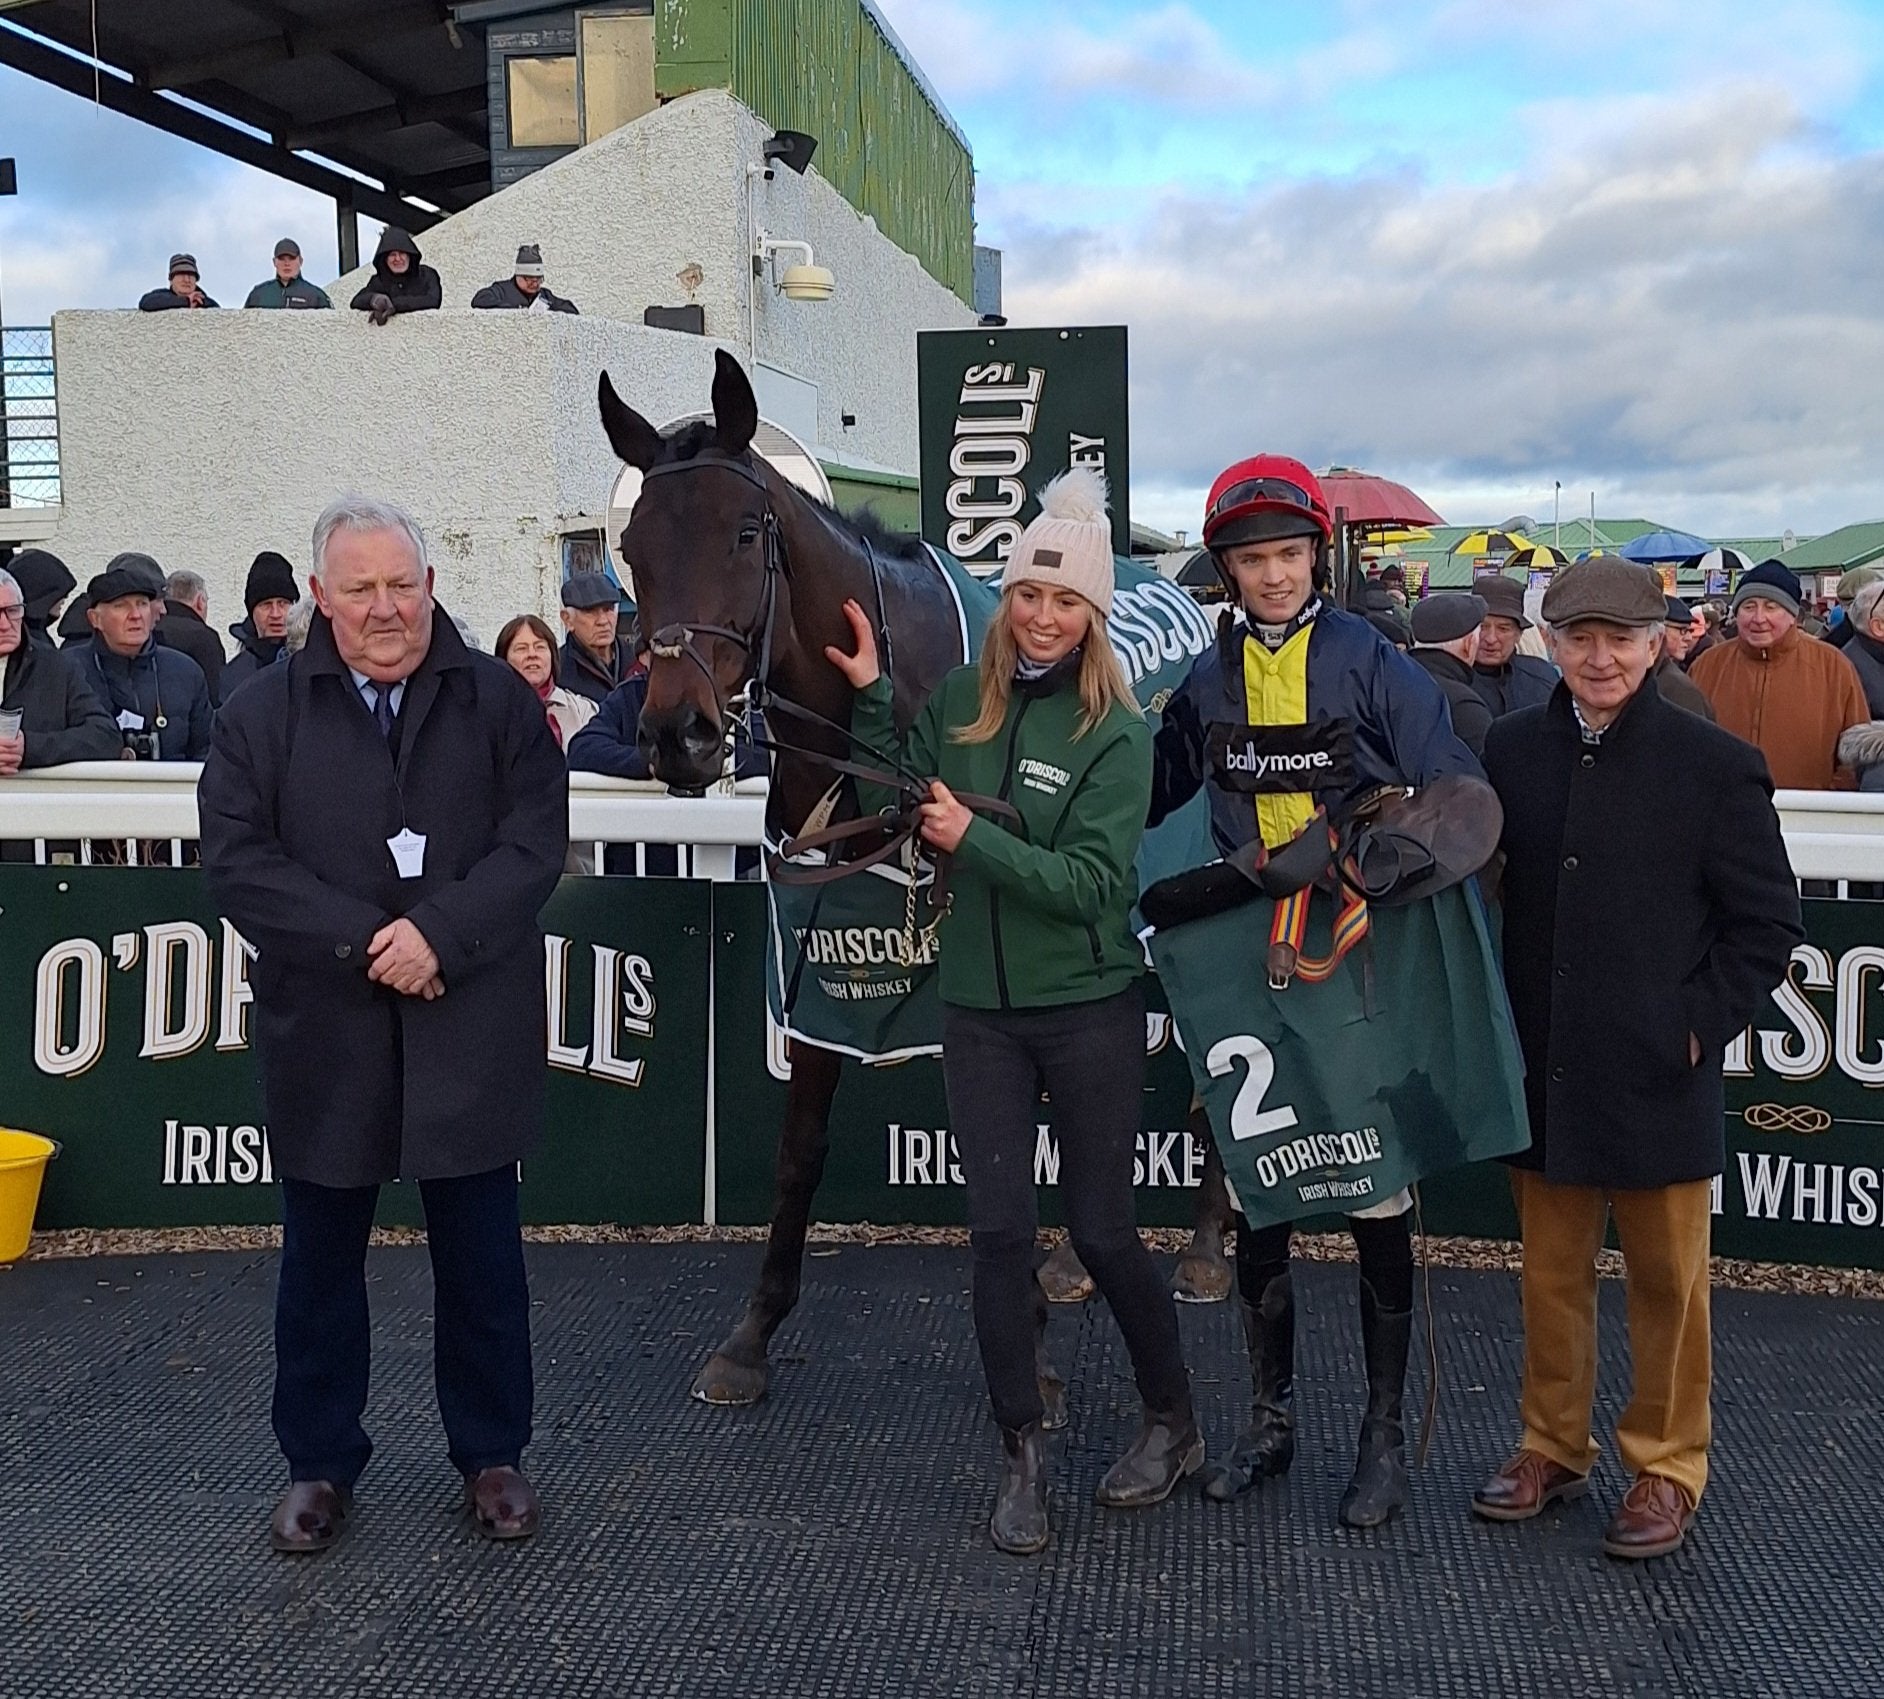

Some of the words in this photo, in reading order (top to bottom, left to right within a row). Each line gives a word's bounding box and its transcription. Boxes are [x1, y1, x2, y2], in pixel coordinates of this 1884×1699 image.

[946, 362, 1046, 577] SCOLLS
[1226, 741, 1334, 780] ballymore.
[848, 977, 913, 1001] WHISKEY
[1205, 1033, 1299, 1142] 2
[887, 1124, 967, 1185] IRI
[1256, 1126, 1382, 1188] O'DRISCOLLS
[1297, 1182, 1330, 1203] IRISH
[1326, 1175, 1375, 1199] WHISKEY
[1736, 1152, 1884, 1227] WHIS
